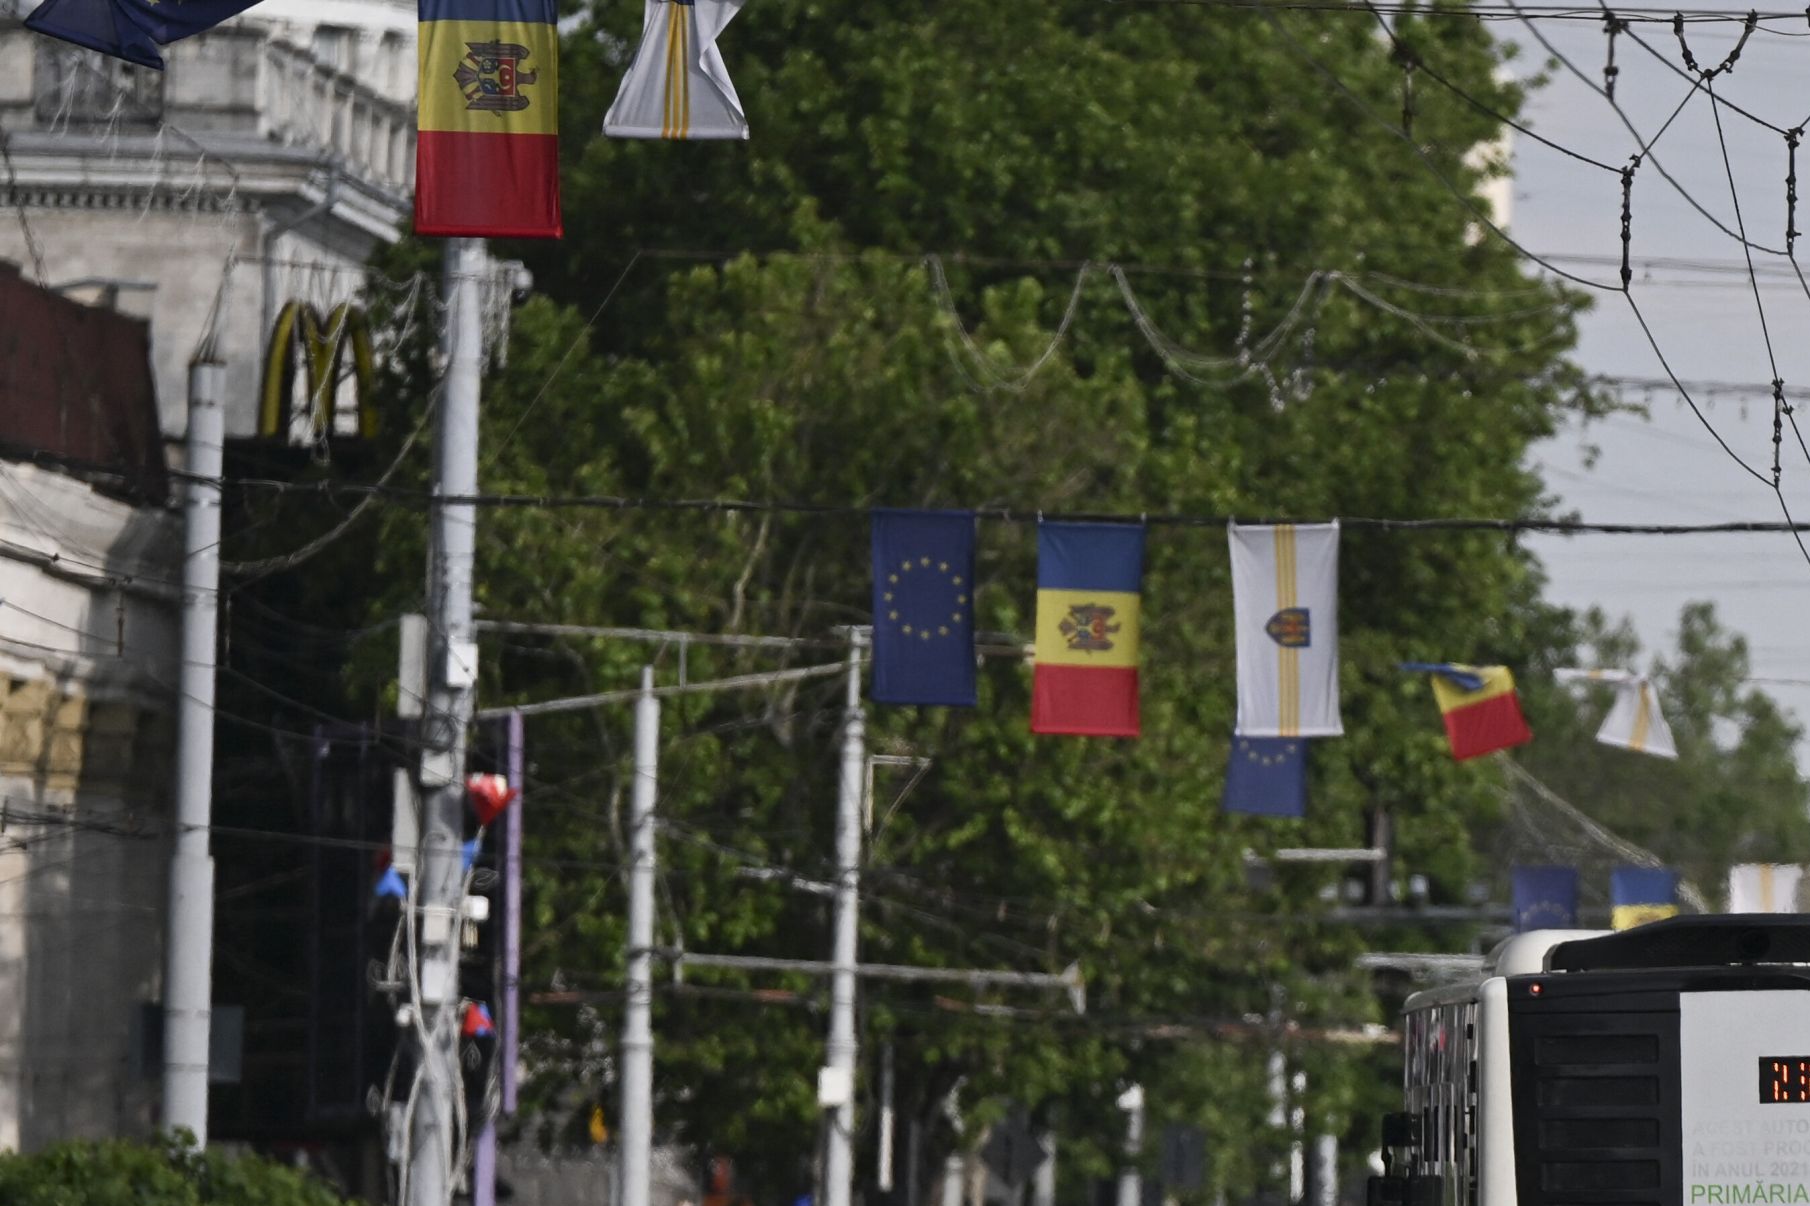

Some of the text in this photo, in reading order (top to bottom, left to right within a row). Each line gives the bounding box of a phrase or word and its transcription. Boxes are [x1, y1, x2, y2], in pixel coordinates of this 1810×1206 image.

[1714, 1162, 1765, 1178] ANUL
[1769, 1162, 1808, 1178] 2021
[1691, 1180, 1810, 1205] PRIMĂRIA
